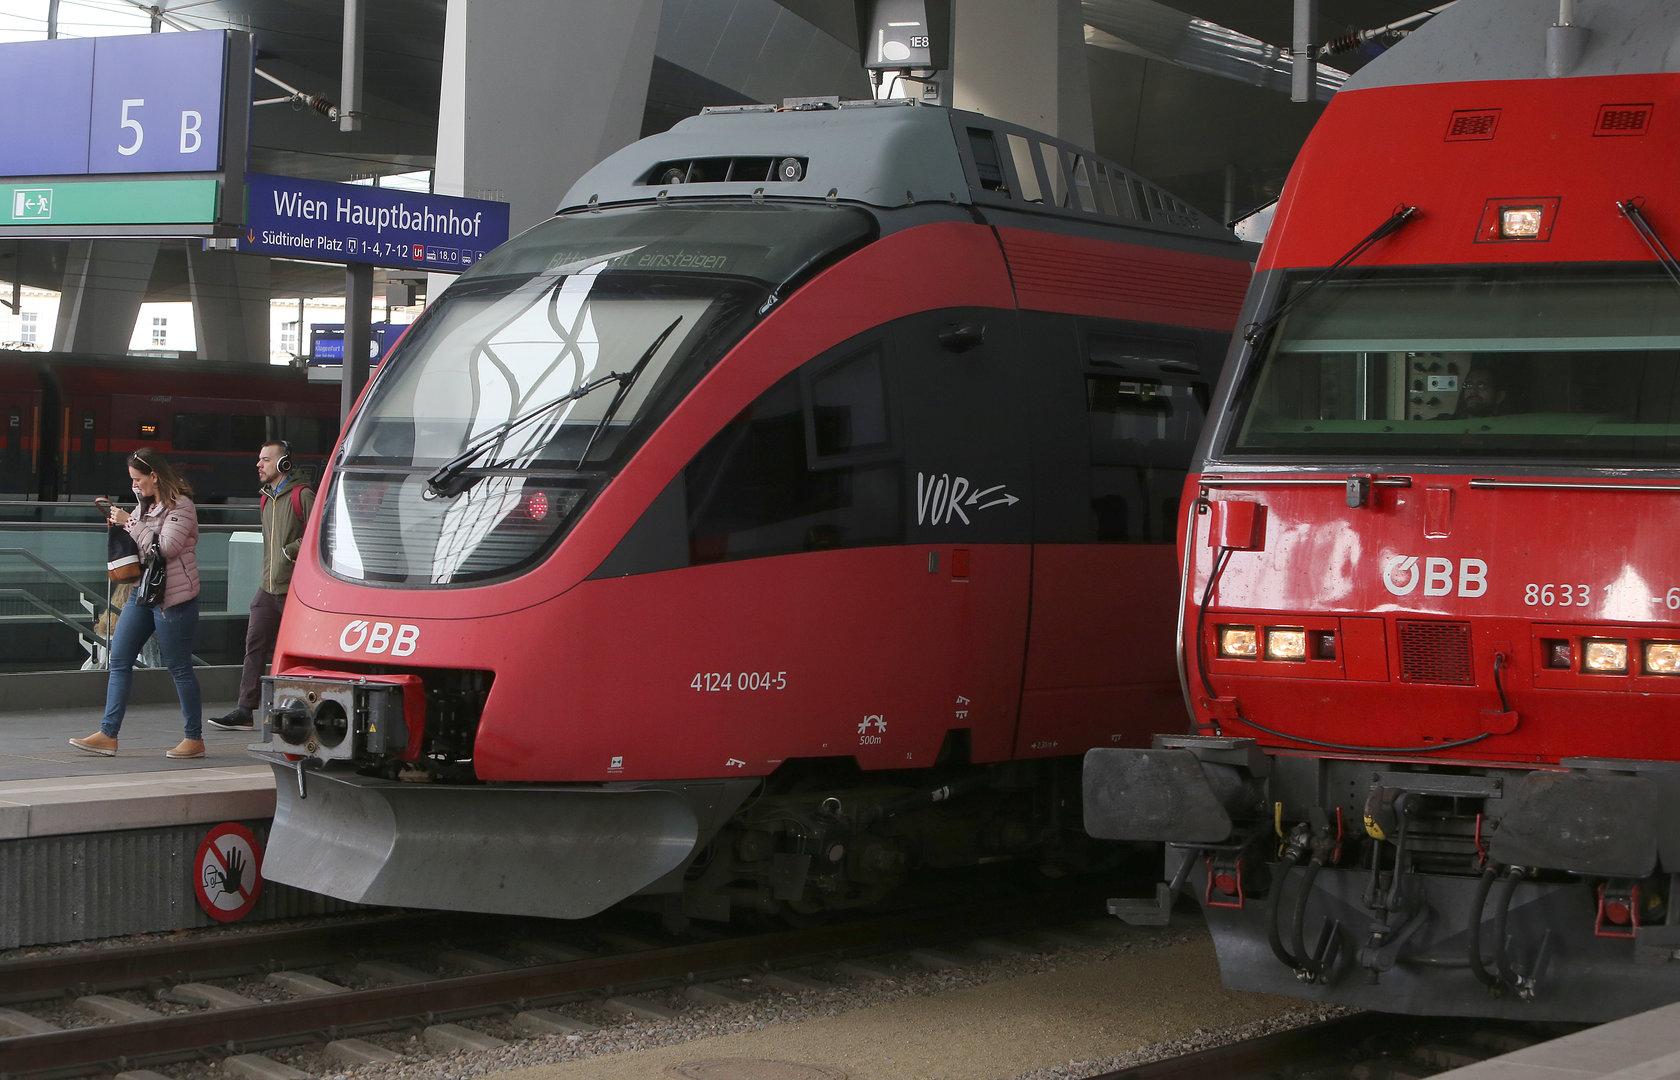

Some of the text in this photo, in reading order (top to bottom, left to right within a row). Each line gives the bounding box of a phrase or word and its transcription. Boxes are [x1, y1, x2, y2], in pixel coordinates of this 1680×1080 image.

[910, 36, 930, 47] 1E8
[118, 98, 202, 156] 5 B
[273, 190, 482, 238] Wien Hauptbahnhof
[262, 230, 314, 248] Südtiroler
[317, 236, 343, 251] Platz
[385, 243, 408, 258] 7-12
[638, 250, 727, 269] einsteigen
[10, 416, 19, 427] 2
[84, 418, 94, 429] 2
[918, 472, 970, 525] VOR
[1383, 555, 1488, 598] ÖBB
[1524, 583, 1680, 610] 8633 1-6
[339, 620, 420, 656] ÖBB
[691, 671, 787, 691] 4124 004-5
